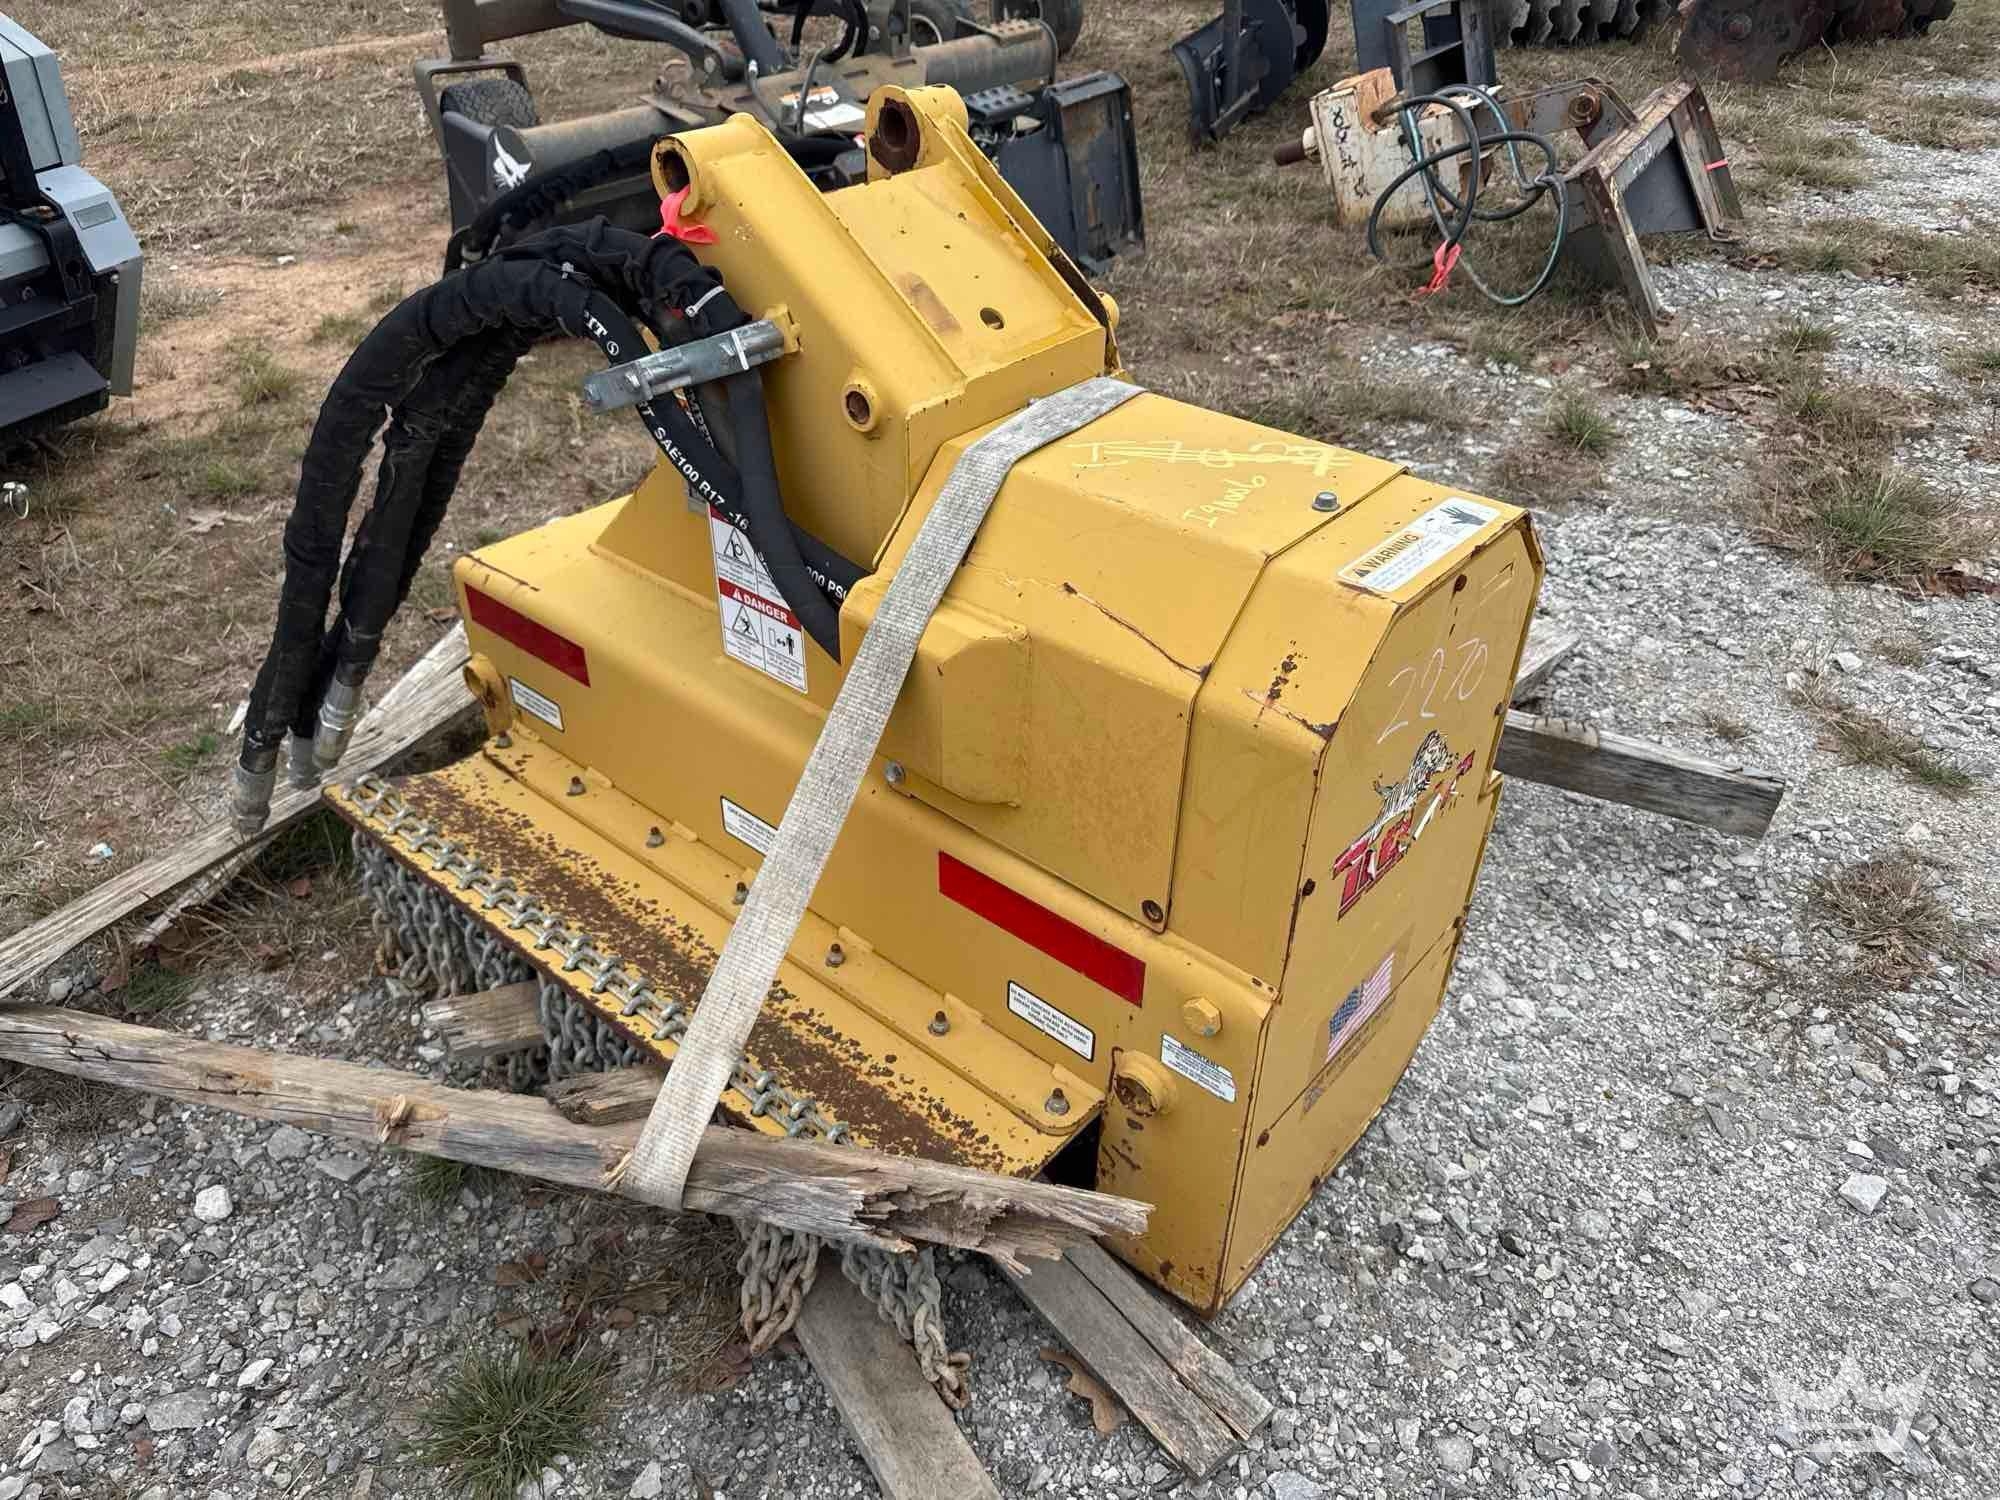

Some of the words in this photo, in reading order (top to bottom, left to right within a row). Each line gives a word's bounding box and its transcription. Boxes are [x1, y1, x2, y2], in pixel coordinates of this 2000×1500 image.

[654, 427, 700, 483] SAE100
[698, 480, 725, 507] R17
[728, 510, 751, 531] -16
[1364, 533, 1420, 570] WARNING
[743, 594, 788, 624] DANGER
[1377, 637, 1488, 745] 2270
